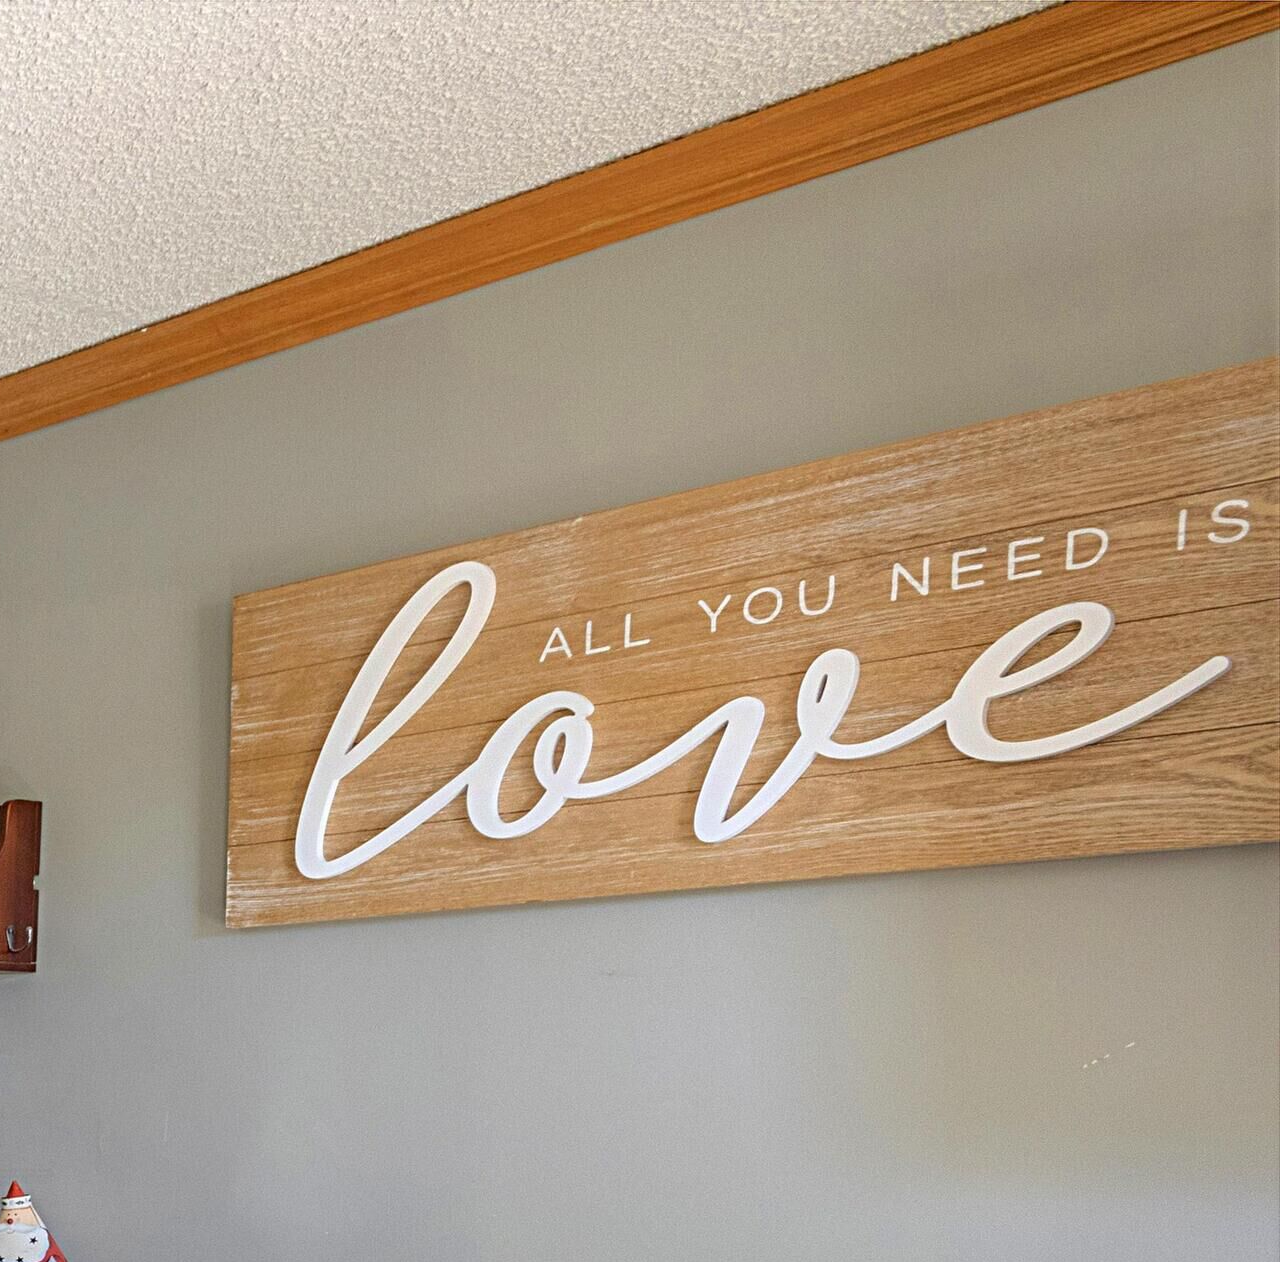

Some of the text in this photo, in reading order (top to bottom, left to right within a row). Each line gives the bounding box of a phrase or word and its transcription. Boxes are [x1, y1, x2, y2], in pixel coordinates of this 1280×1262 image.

[537, 497, 1253, 664] ALL YOU NEED IS
[293, 558, 1233, 881] love
